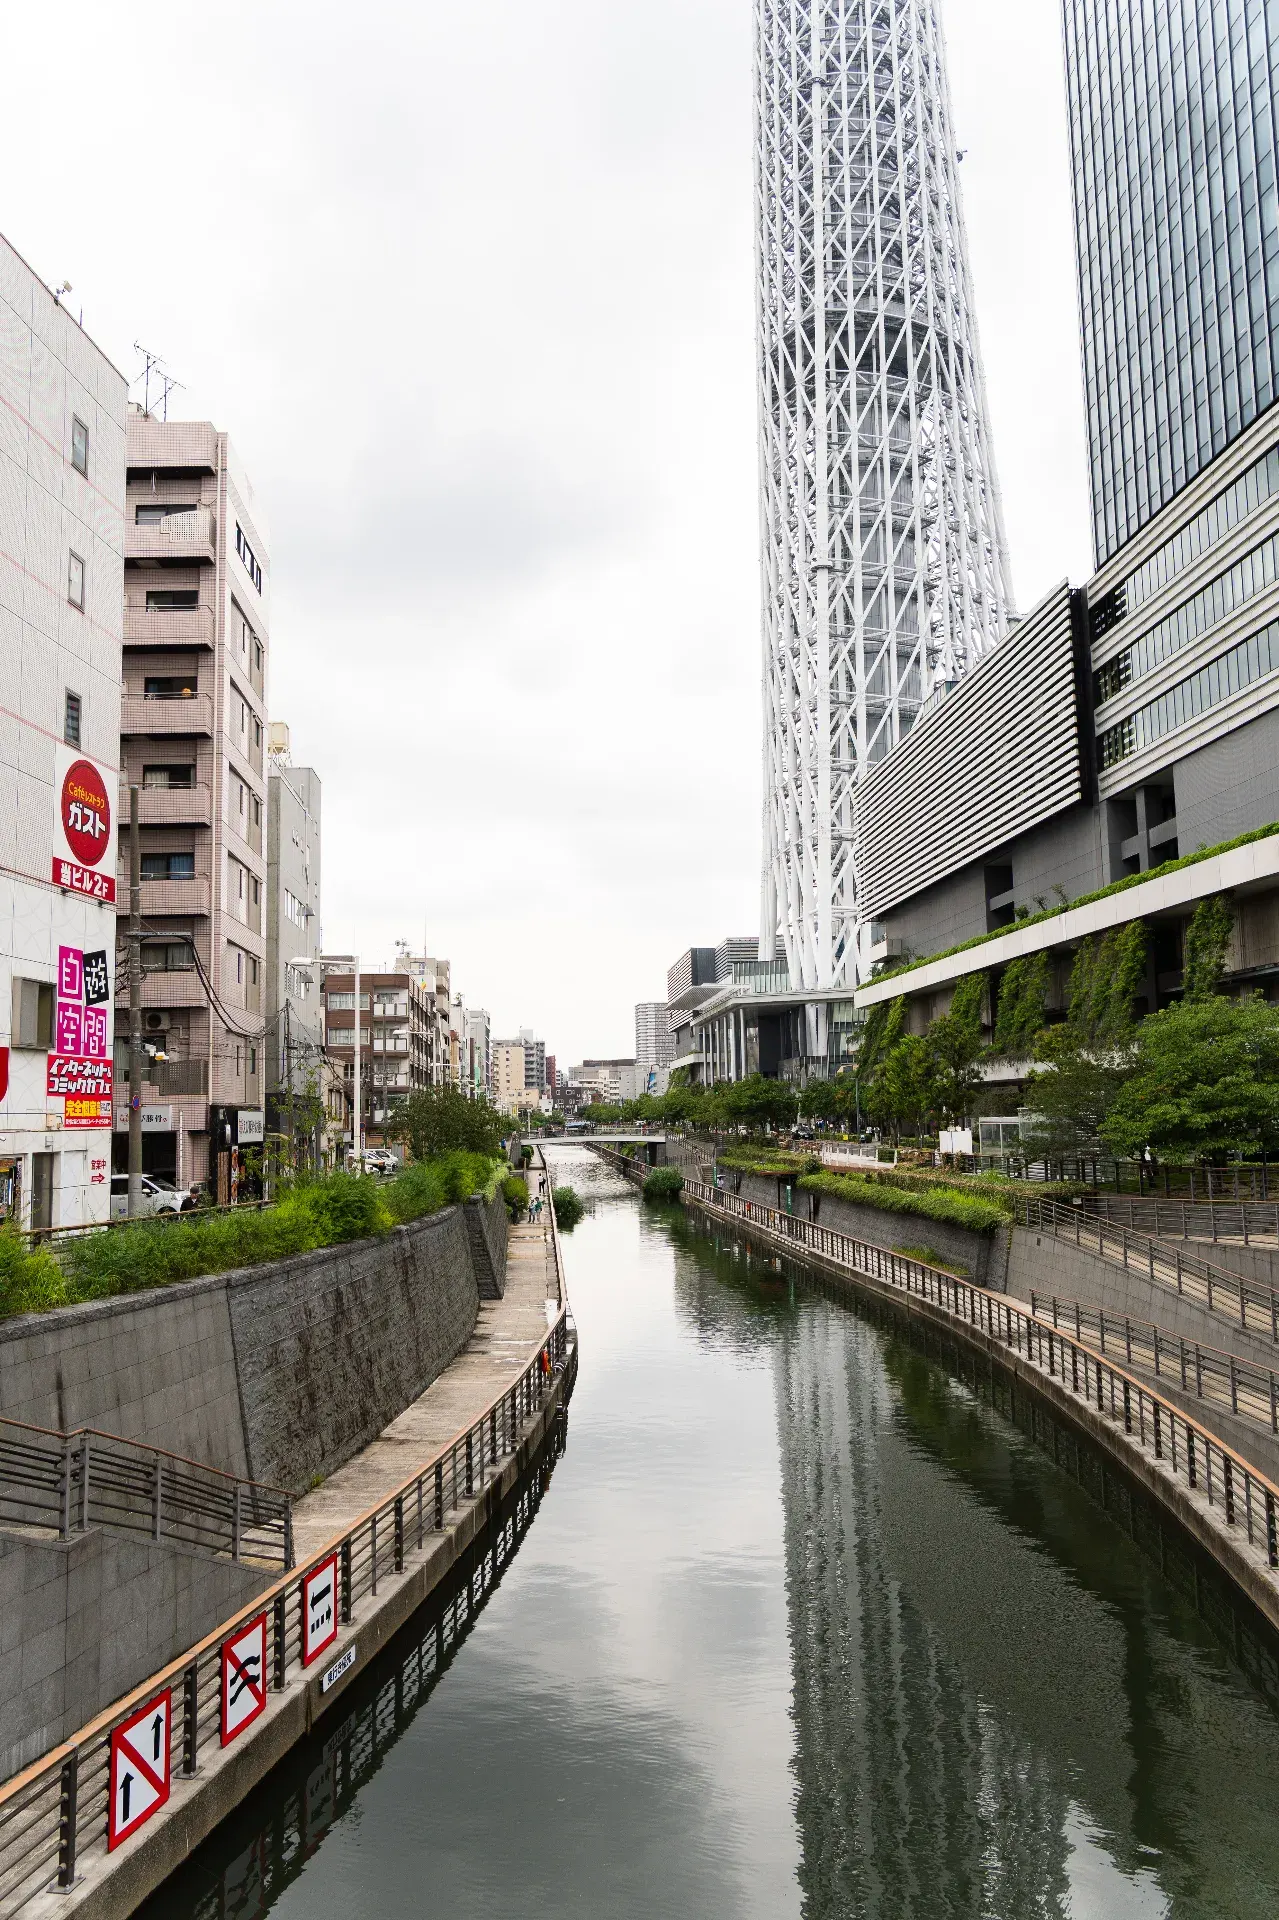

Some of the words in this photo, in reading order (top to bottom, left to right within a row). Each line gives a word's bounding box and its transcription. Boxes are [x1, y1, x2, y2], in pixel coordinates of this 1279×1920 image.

[69, 802, 106, 839] ガスト
[61, 863, 108, 898] 当ビル2F
[49, 1078, 111, 1094] コミックカフェ
